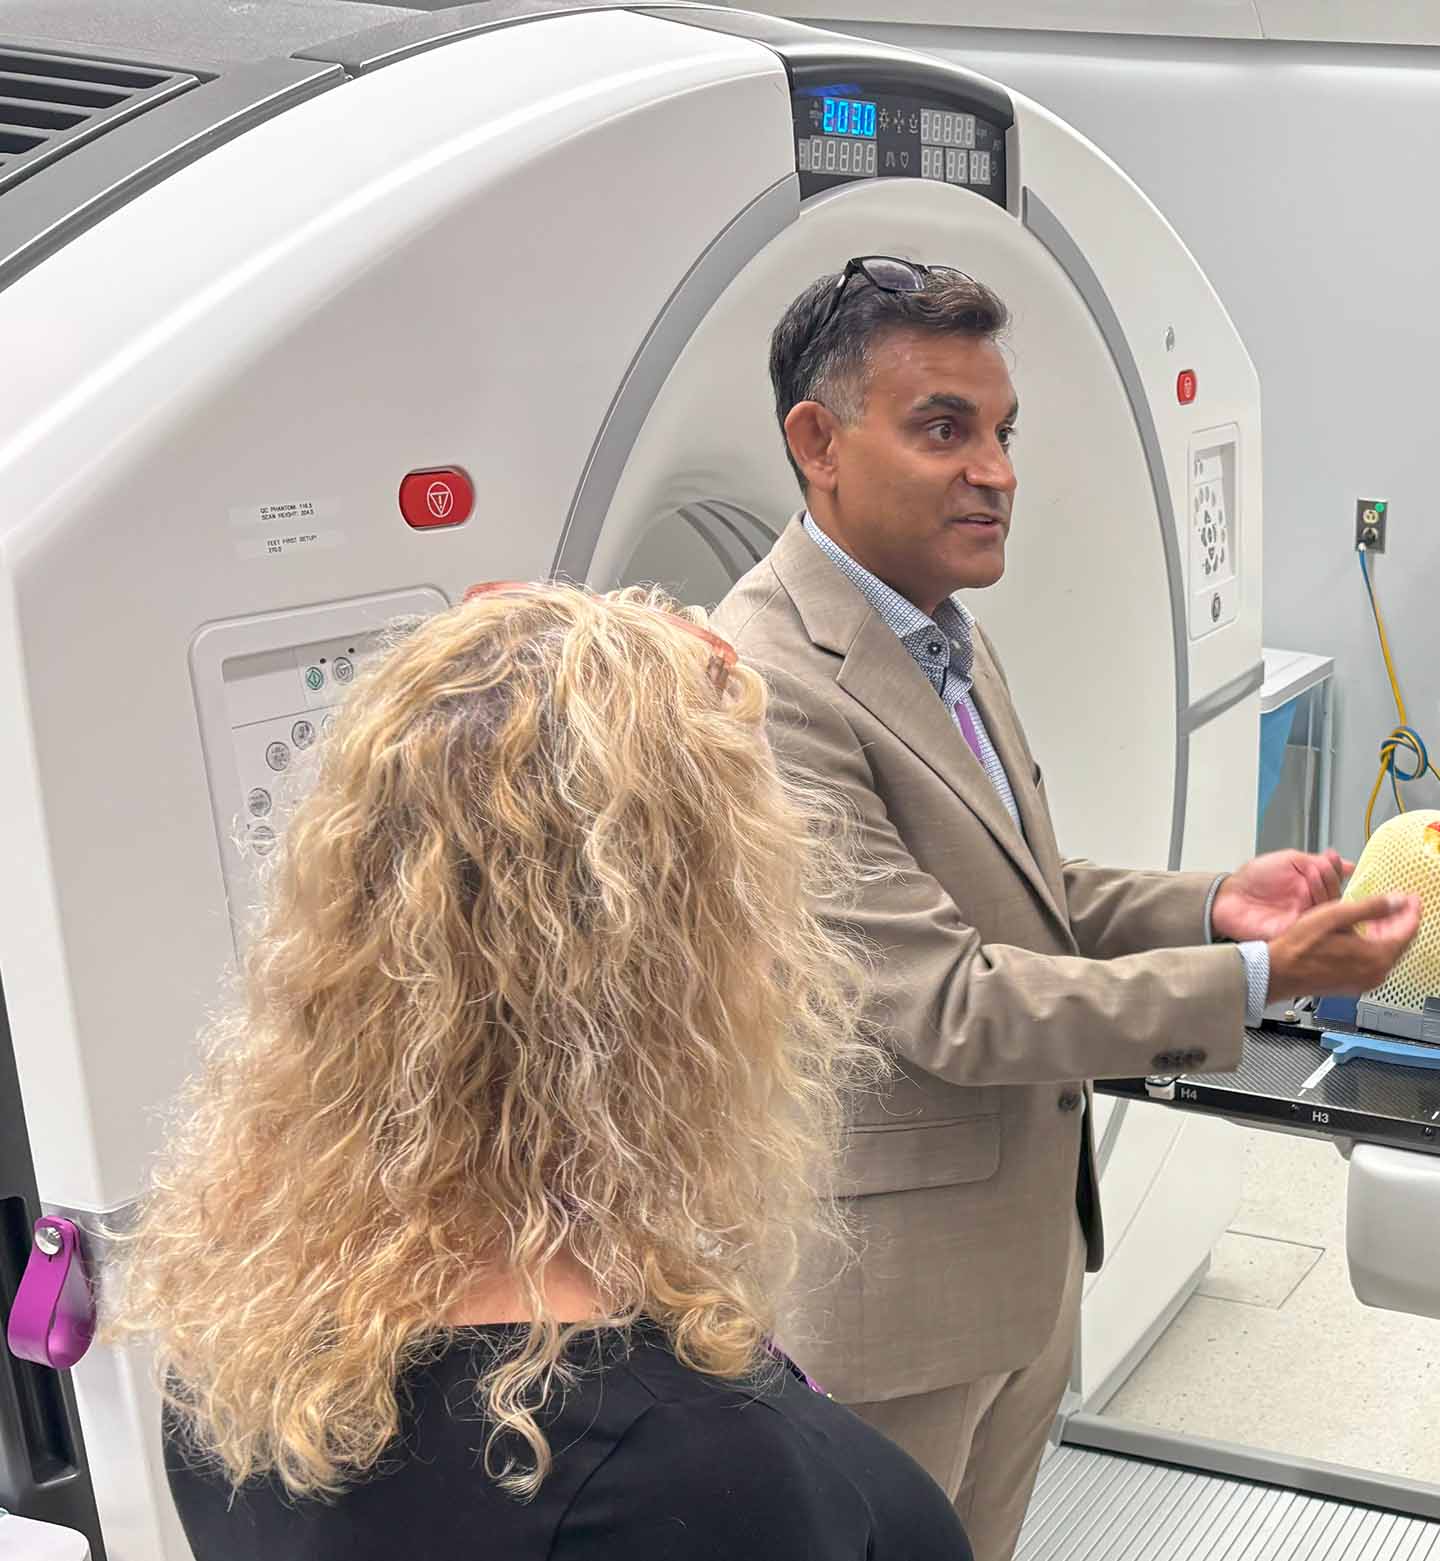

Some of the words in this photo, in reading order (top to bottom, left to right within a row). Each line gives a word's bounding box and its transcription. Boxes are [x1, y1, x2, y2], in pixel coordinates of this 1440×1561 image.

[823, 98, 876, 137] 203.0
[1180, 1087, 1198, 1100] H4
[1312, 1111, 1330, 1124] H3
